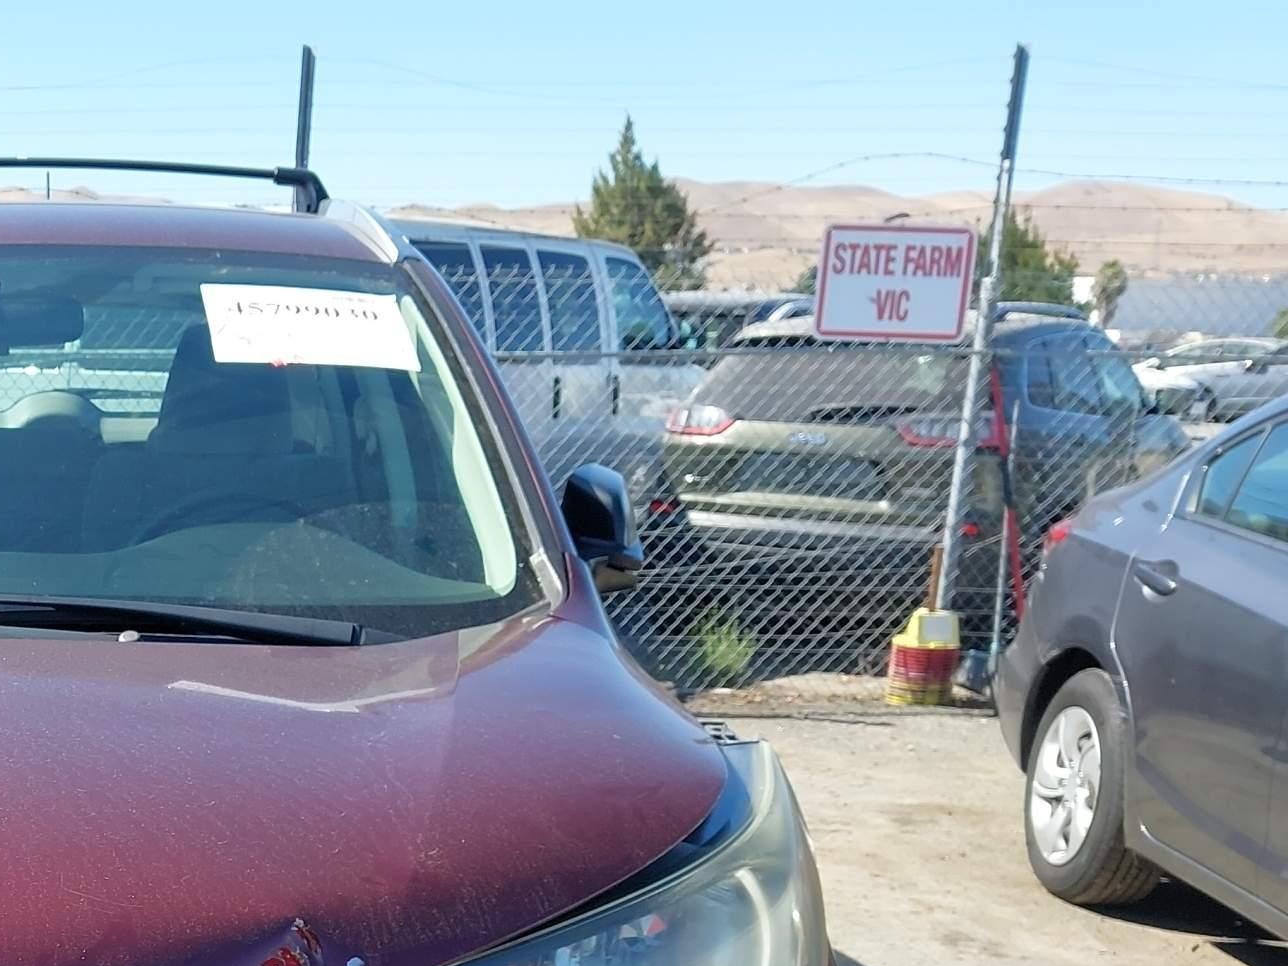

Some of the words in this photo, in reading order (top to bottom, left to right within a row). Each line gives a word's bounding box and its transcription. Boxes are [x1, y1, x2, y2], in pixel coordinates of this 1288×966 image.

[832, 243, 897, 275] STATE
[902, 245, 964, 277] FARM
[876, 288, 910, 321] VIC
